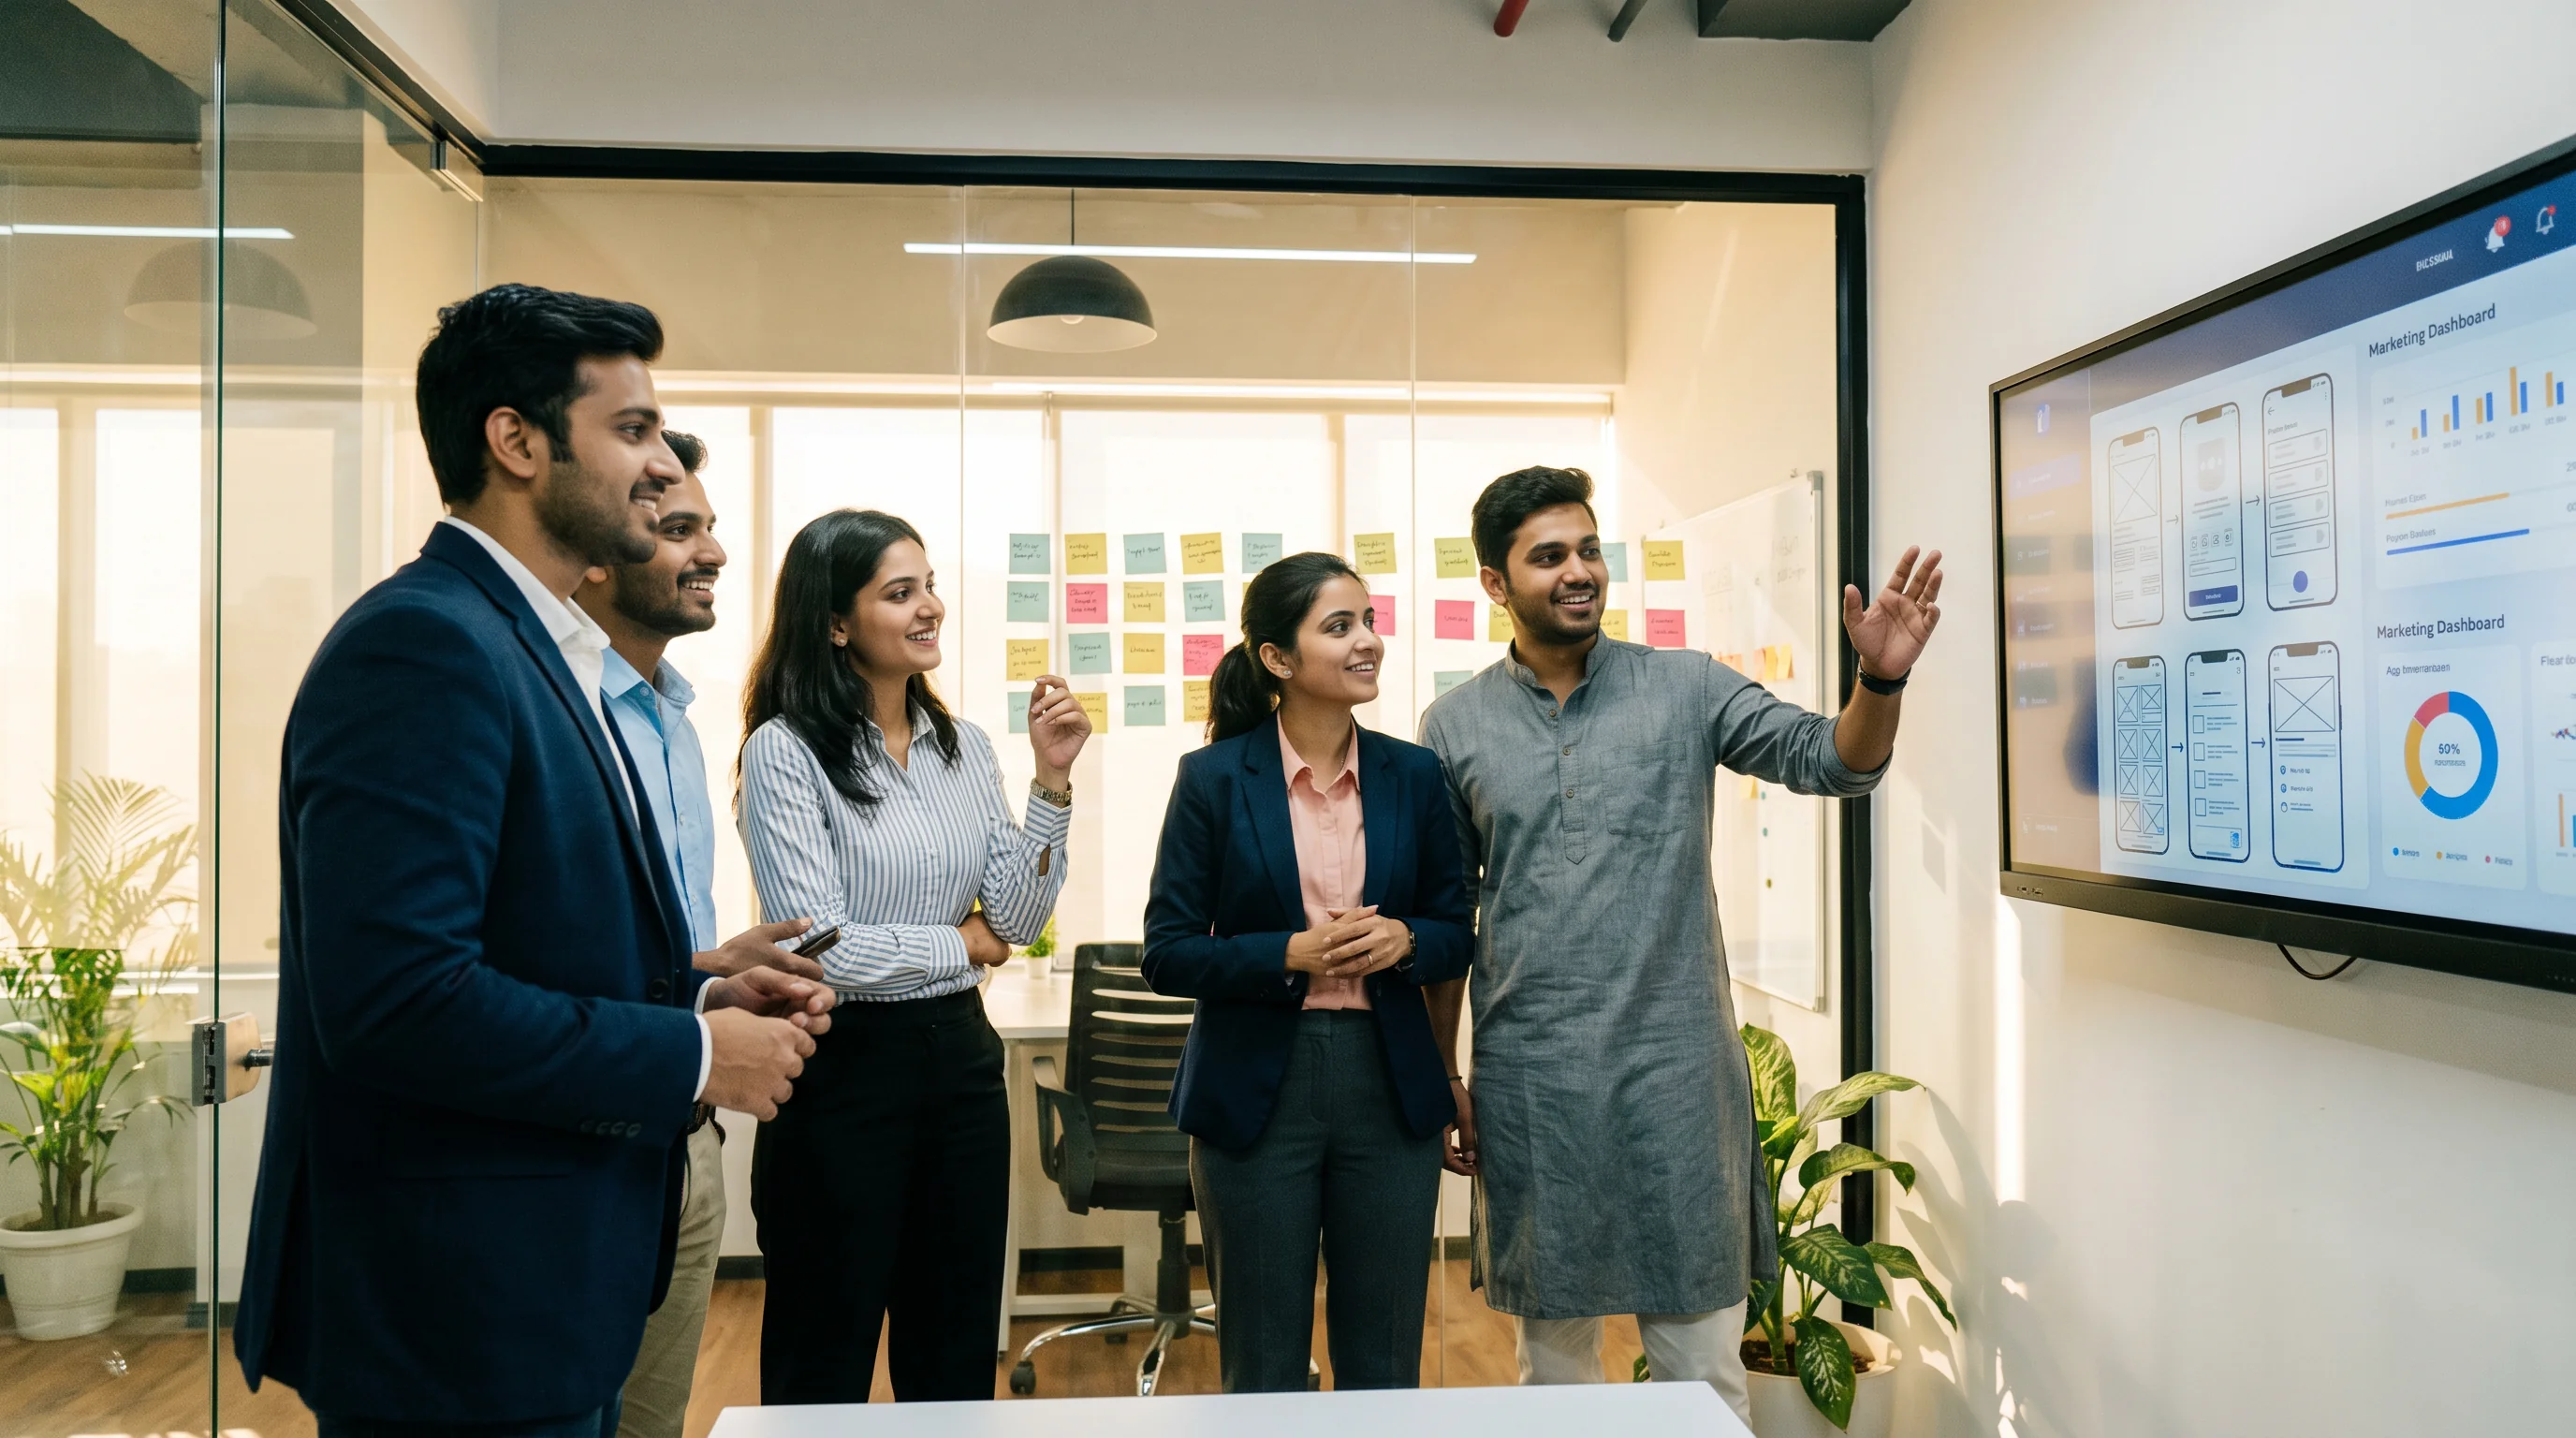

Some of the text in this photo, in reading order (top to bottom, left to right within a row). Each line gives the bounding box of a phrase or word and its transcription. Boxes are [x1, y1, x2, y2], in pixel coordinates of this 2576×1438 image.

[2369, 302, 2496, 358] Marketing Dashboard
[2377, 614, 2505, 638] Marketing Dashboard
